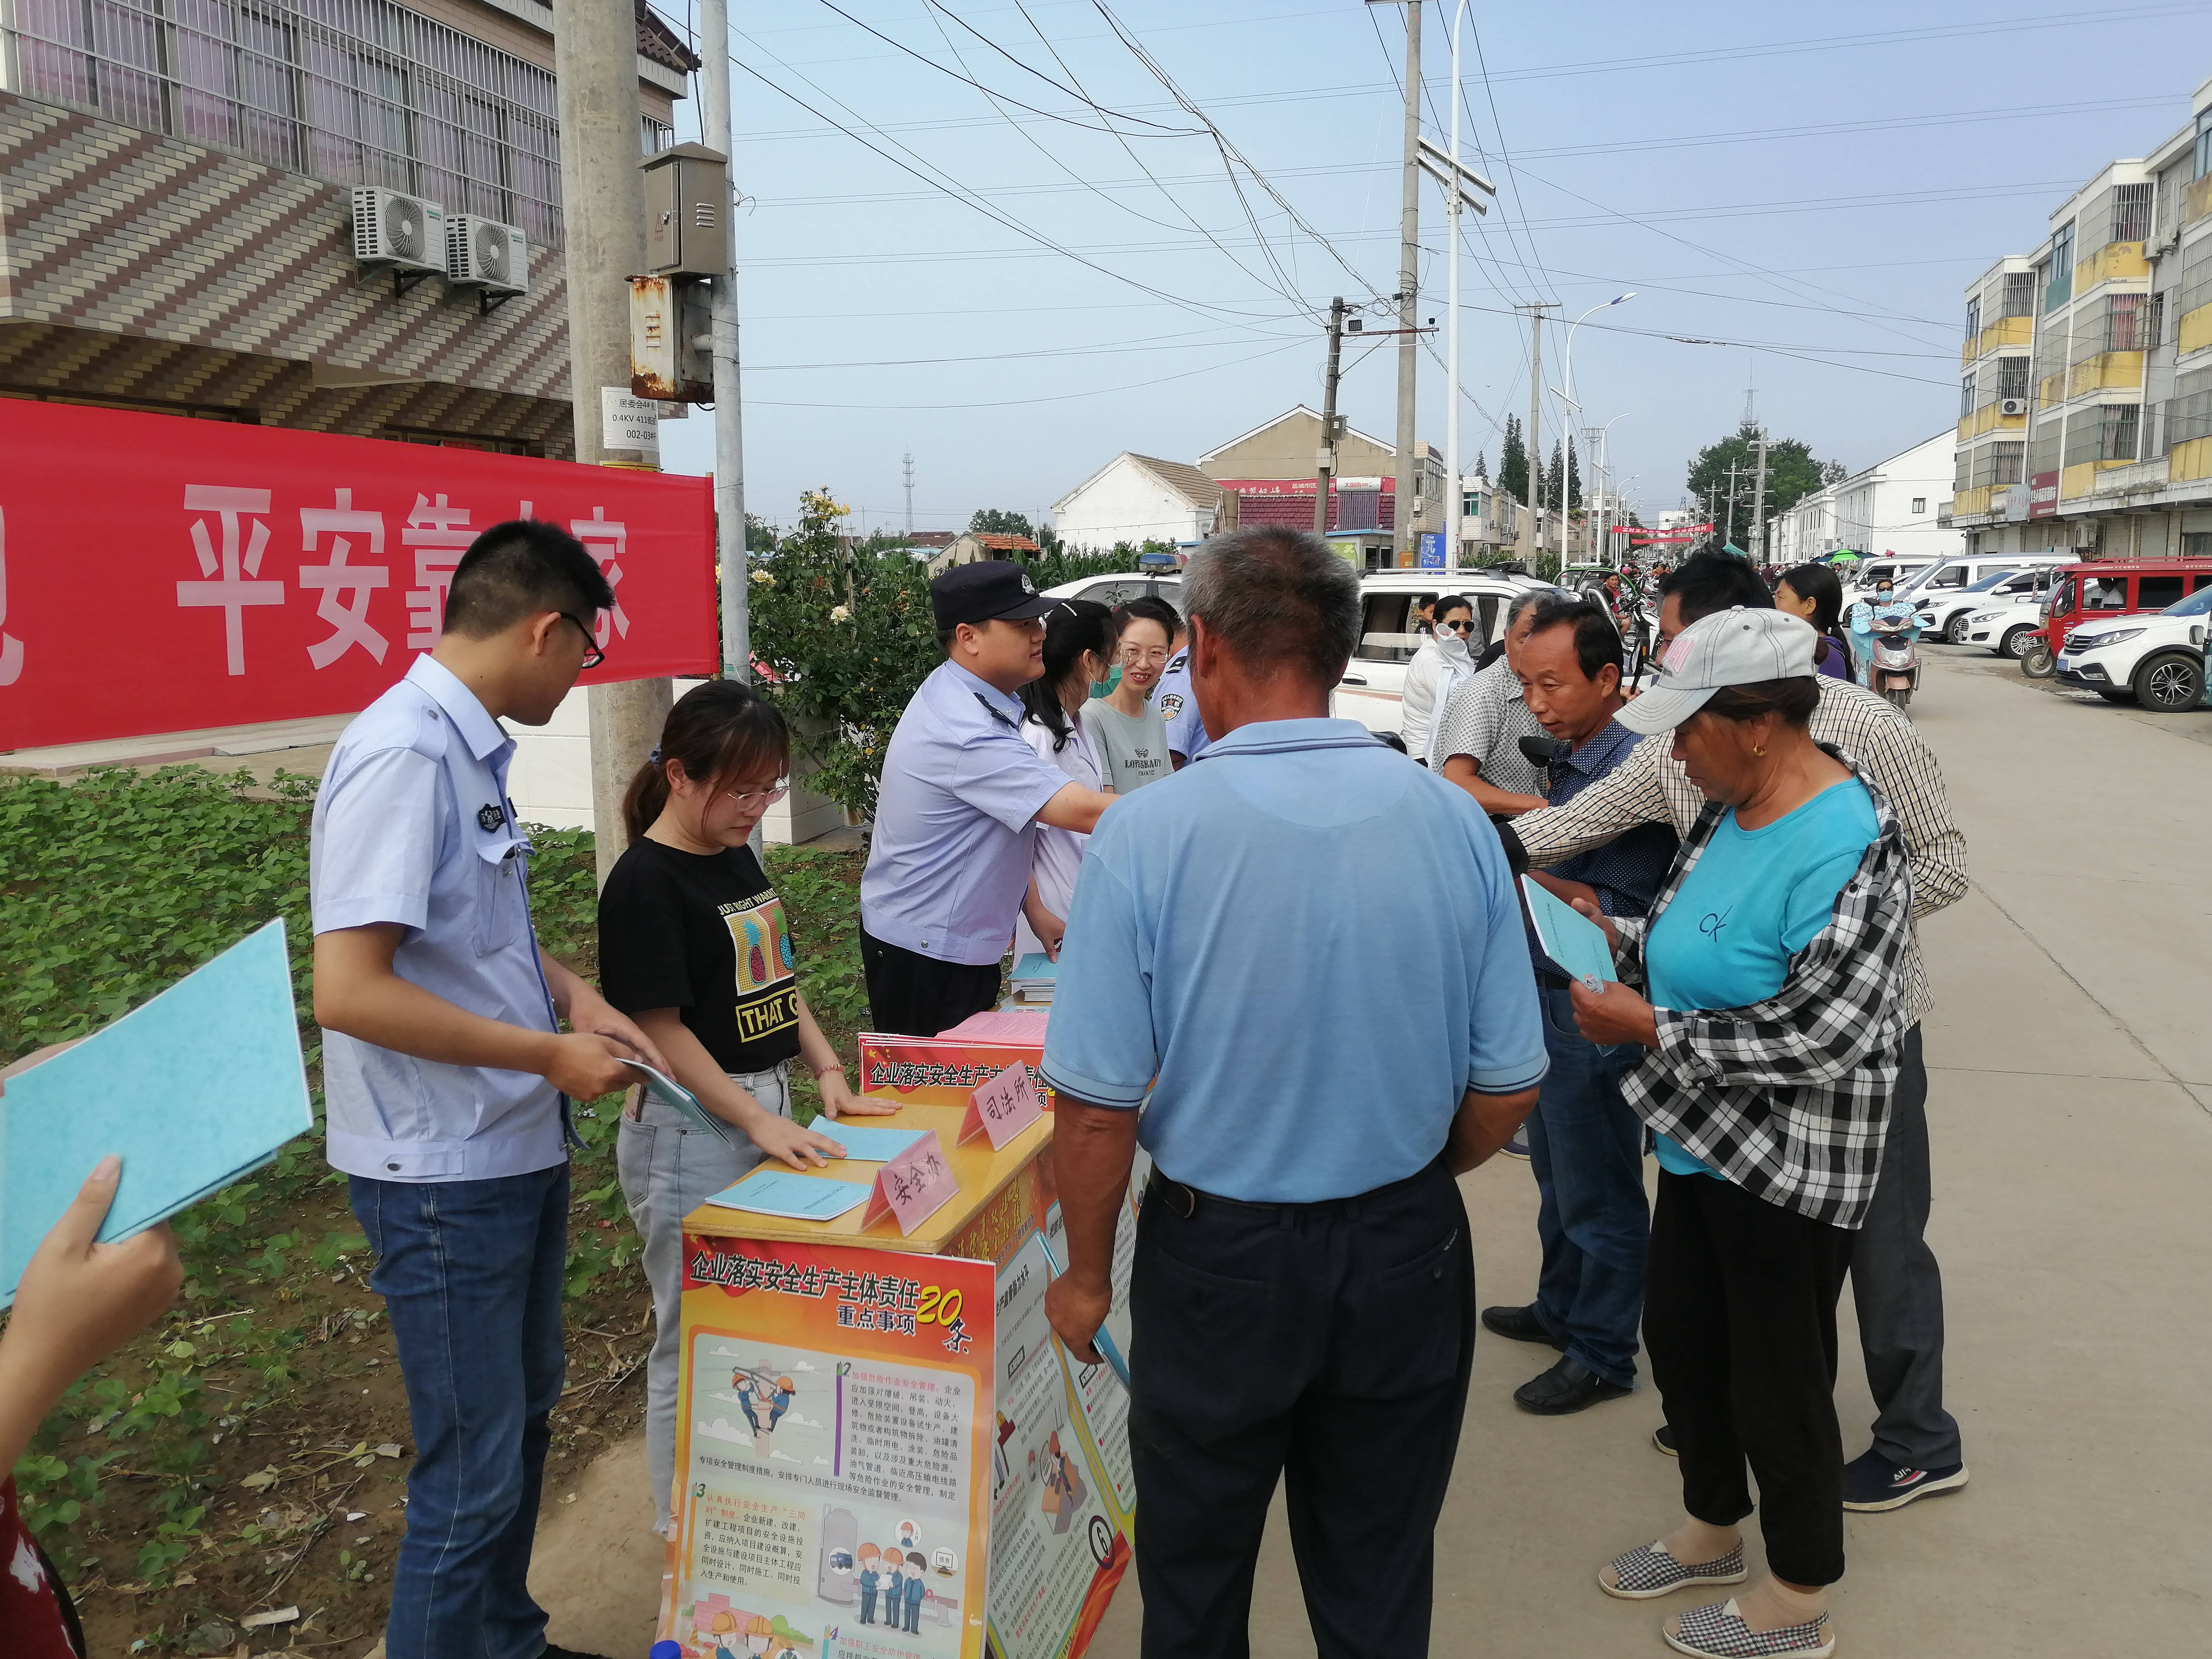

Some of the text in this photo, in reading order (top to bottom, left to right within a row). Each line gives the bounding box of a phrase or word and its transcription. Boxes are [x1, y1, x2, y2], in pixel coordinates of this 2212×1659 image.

[733, 897, 753, 912] RIGHT
[741, 998, 784, 1033] THAT
[986, 1075, 1030, 1119] 司法所
[690, 1249, 920, 1311] 企业落实安全生产主体责任
[915, 1285, 963, 1326] 20
[943, 1317, 973, 1354] 条
[836, 1305, 916, 1337] 重点事项
[697, 1483, 706, 1498] 3
[705, 1519, 804, 1546] 扩建工程项目的安全设施投
[1096, 1526, 1109, 1558] 6
[703, 1543, 802, 1572] 全设施与建设项目主体工程应
